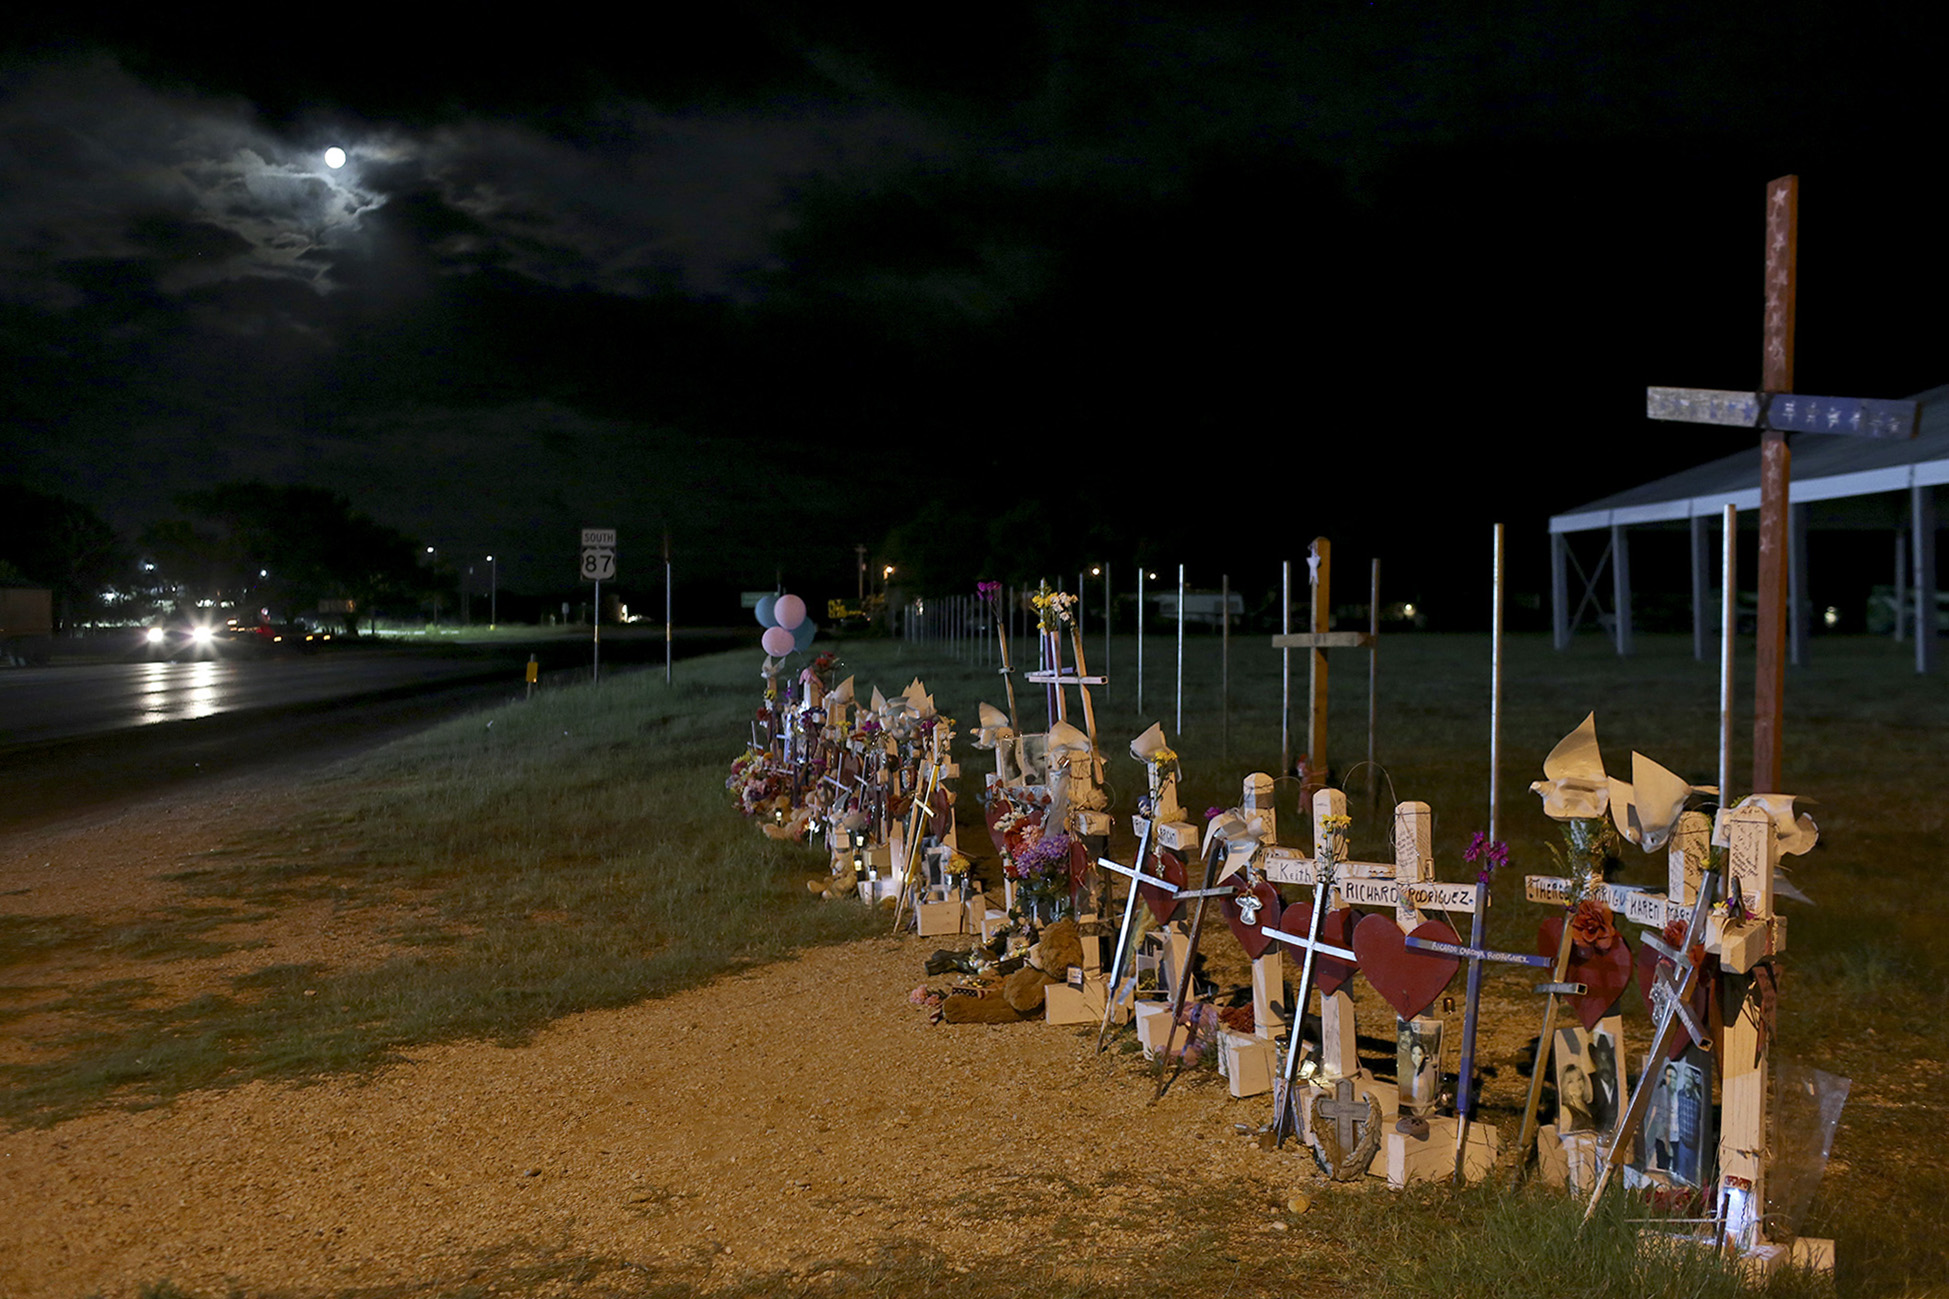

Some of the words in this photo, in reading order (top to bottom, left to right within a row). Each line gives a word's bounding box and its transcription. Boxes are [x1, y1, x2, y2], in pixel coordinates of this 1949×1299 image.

[584, 532, 614, 543] SOUTH
[585, 554, 612, 573] 87
[1280, 862, 1312, 883] Keith
[1346, 881, 1399, 904] RICHARD
[1629, 896, 1660, 921] KAREN
